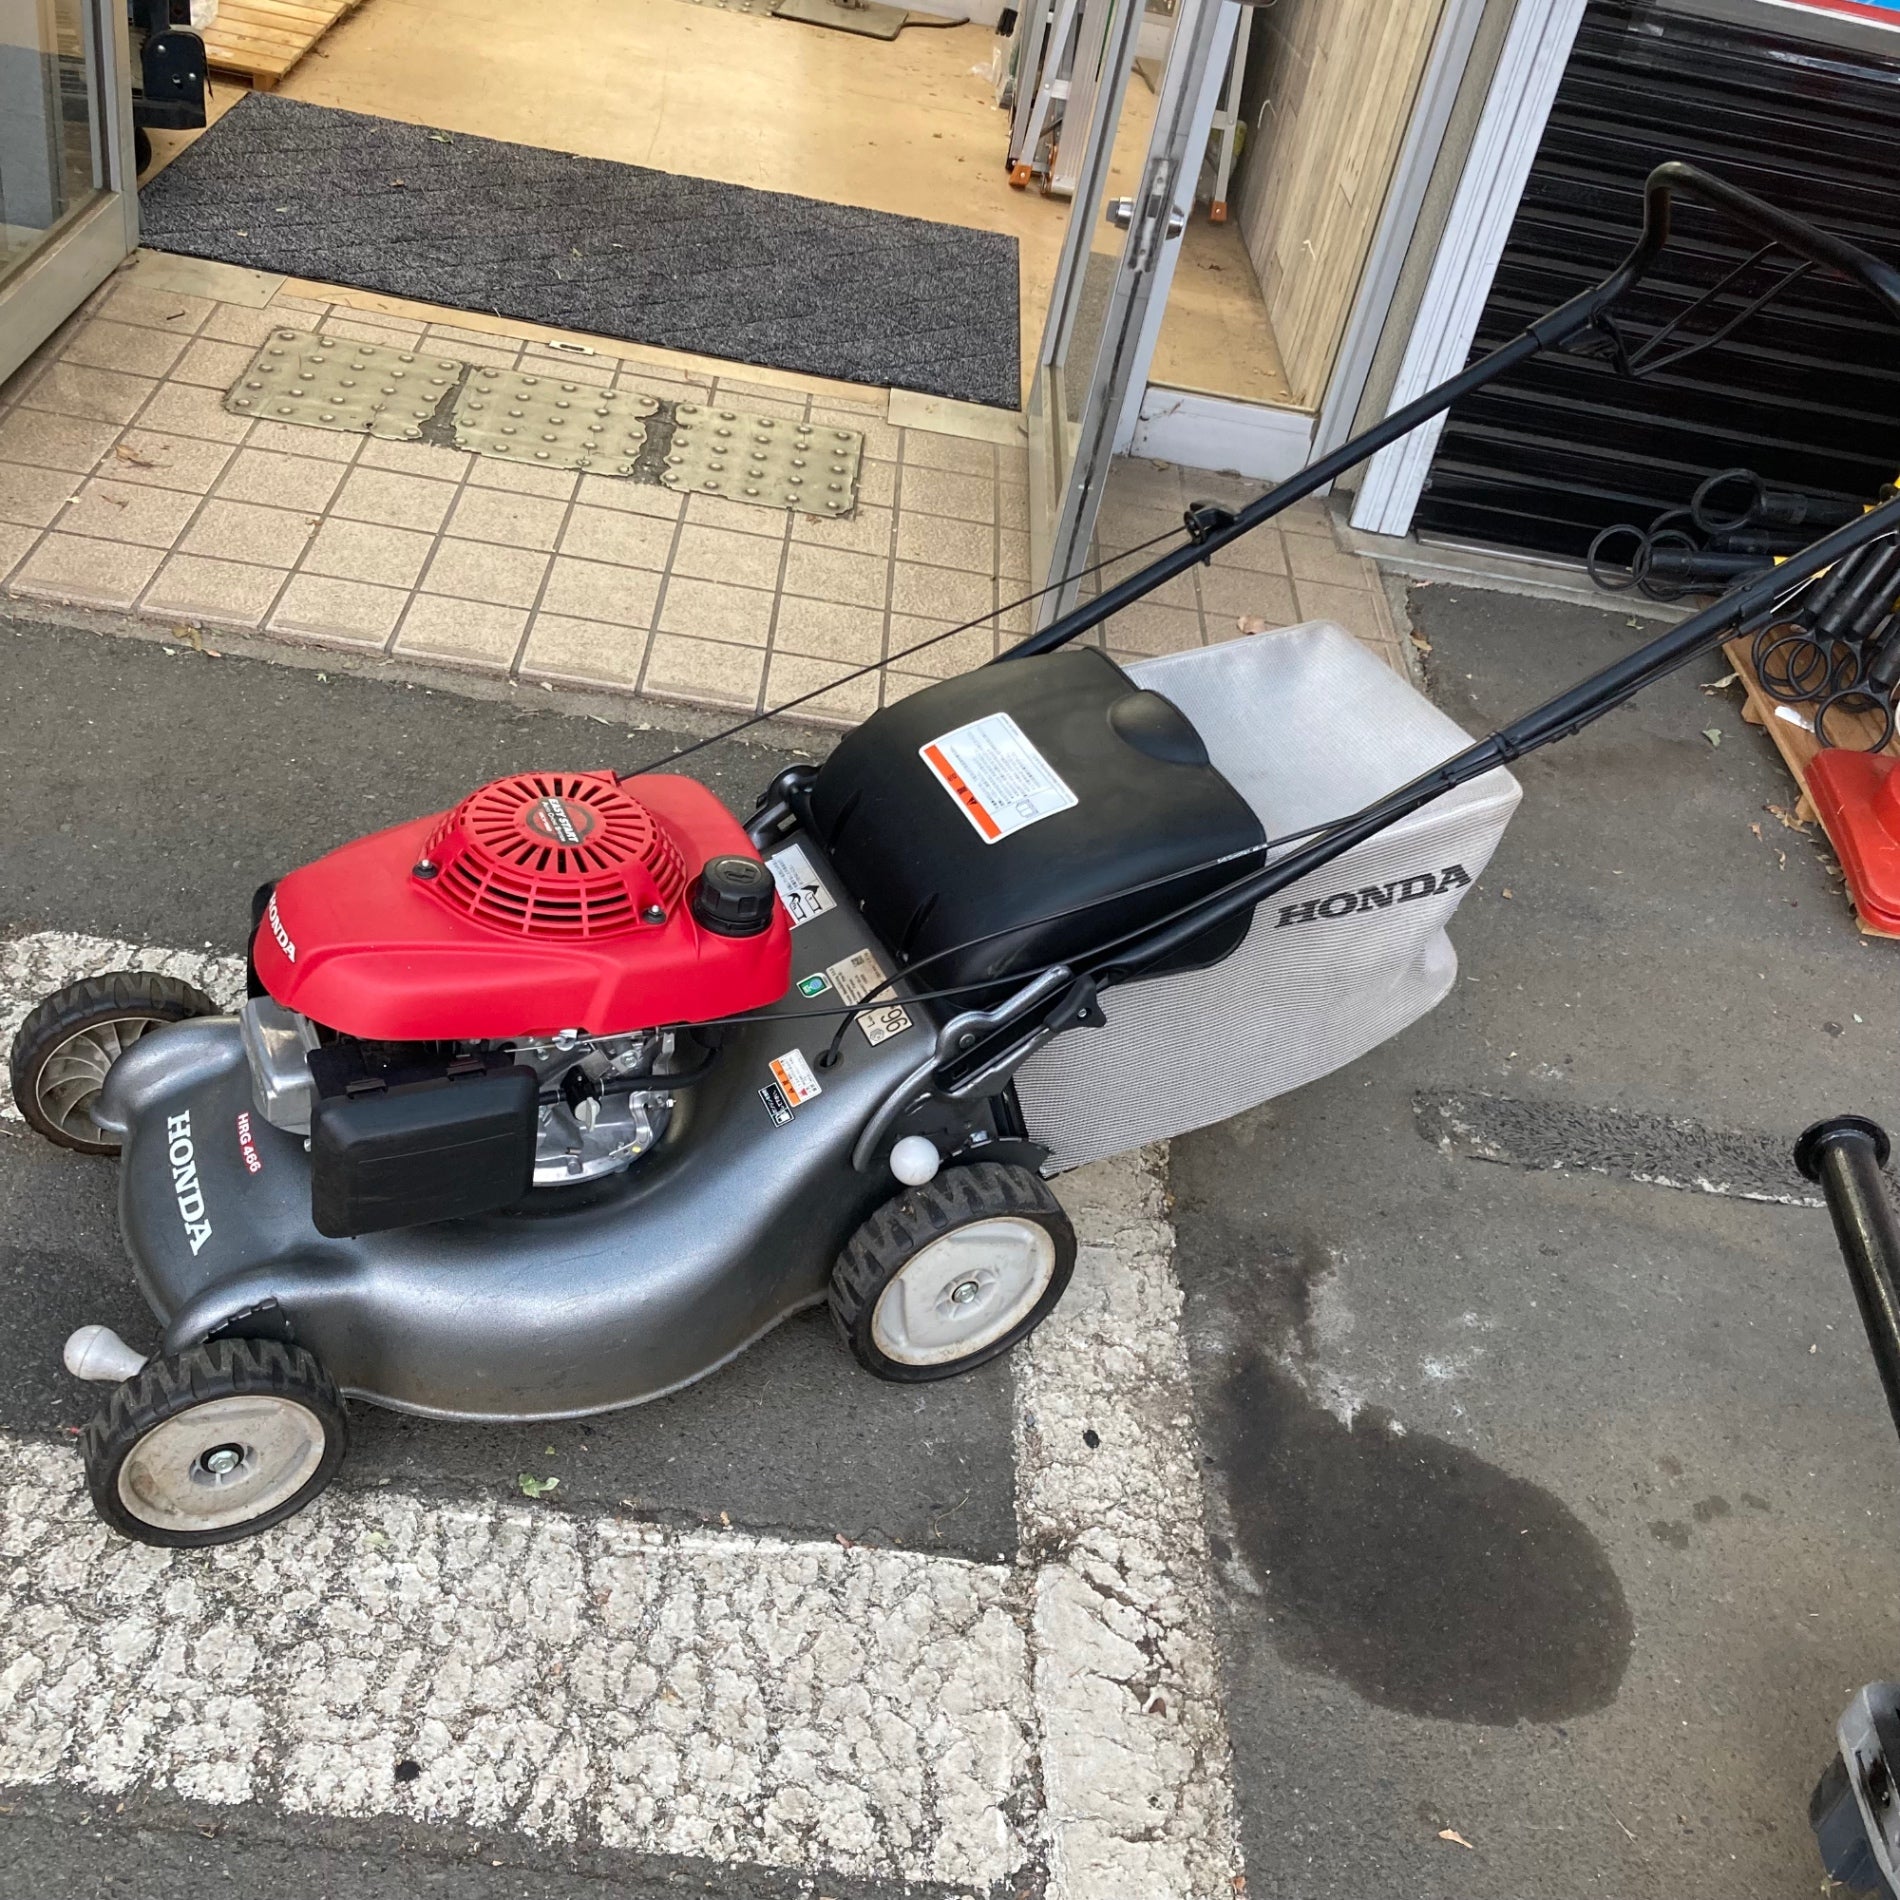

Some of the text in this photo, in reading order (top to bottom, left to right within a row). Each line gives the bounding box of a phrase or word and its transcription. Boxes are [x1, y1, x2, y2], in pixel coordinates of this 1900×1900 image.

[548, 798, 567, 818] EASY
[558, 817, 580, 843] START
[268, 891, 296, 963] HONDA
[1274, 864, 1472, 929] HONDA
[880, 1008, 908, 1033] 96
[238, 1112, 262, 1173] HRG 466
[167, 1109, 213, 1257] HONDA
